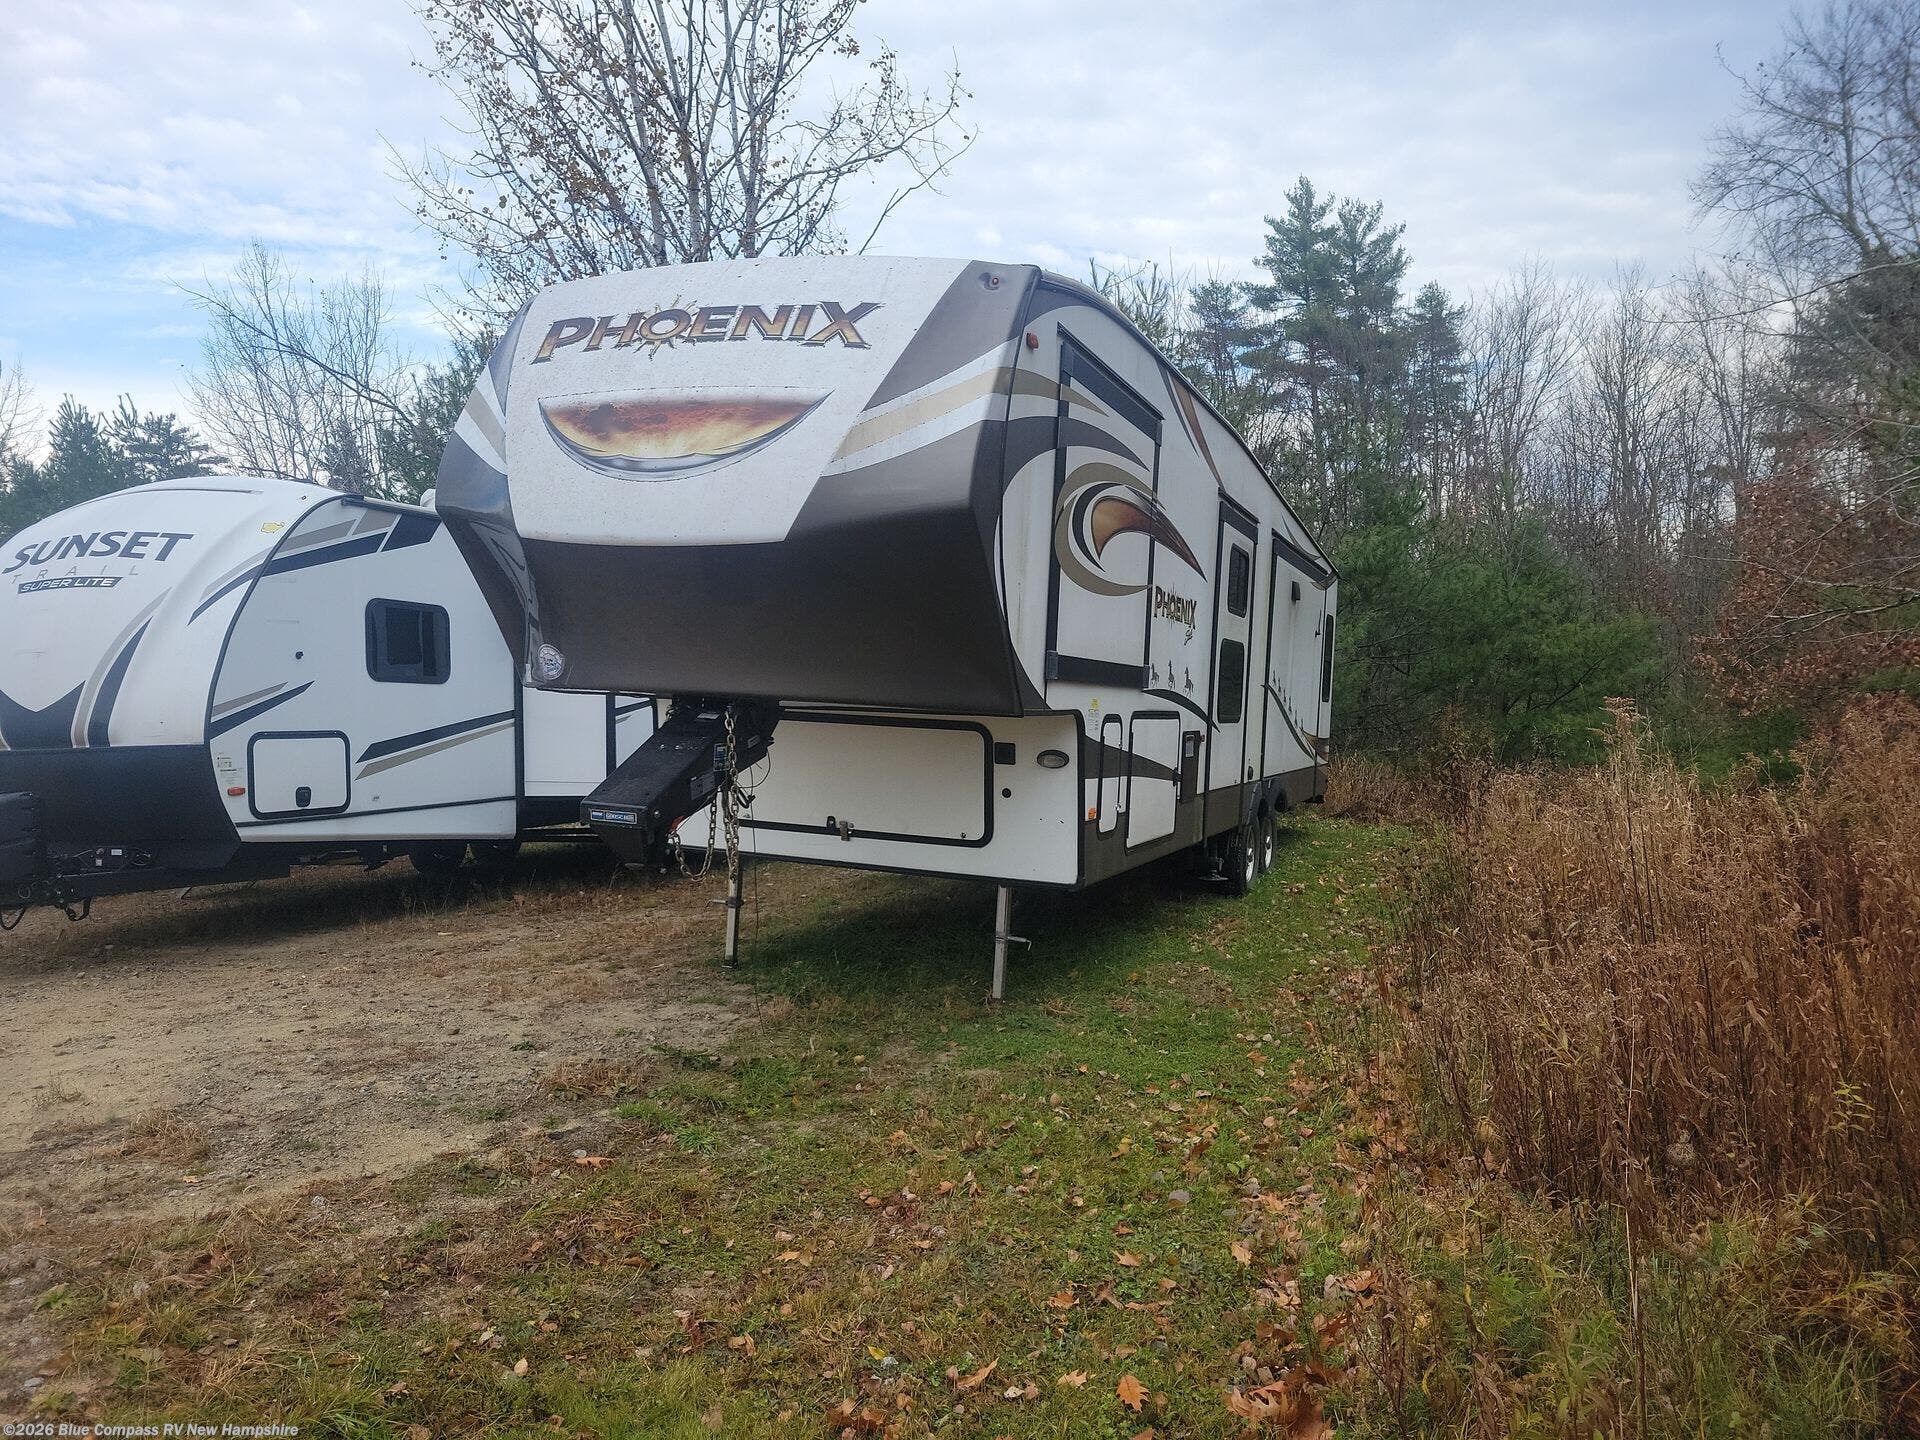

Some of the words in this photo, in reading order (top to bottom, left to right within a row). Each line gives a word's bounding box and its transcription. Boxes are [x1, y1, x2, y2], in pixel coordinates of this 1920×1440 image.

[531, 301, 881, 363] PHOENIX
[3, 531, 193, 574] SUNSET
[11, 564, 140, 584] TRAIL
[21, 578, 72, 592] SUPER
[74, 577, 115, 587] LITE
[1153, 586, 1197, 630] PHOENIX
